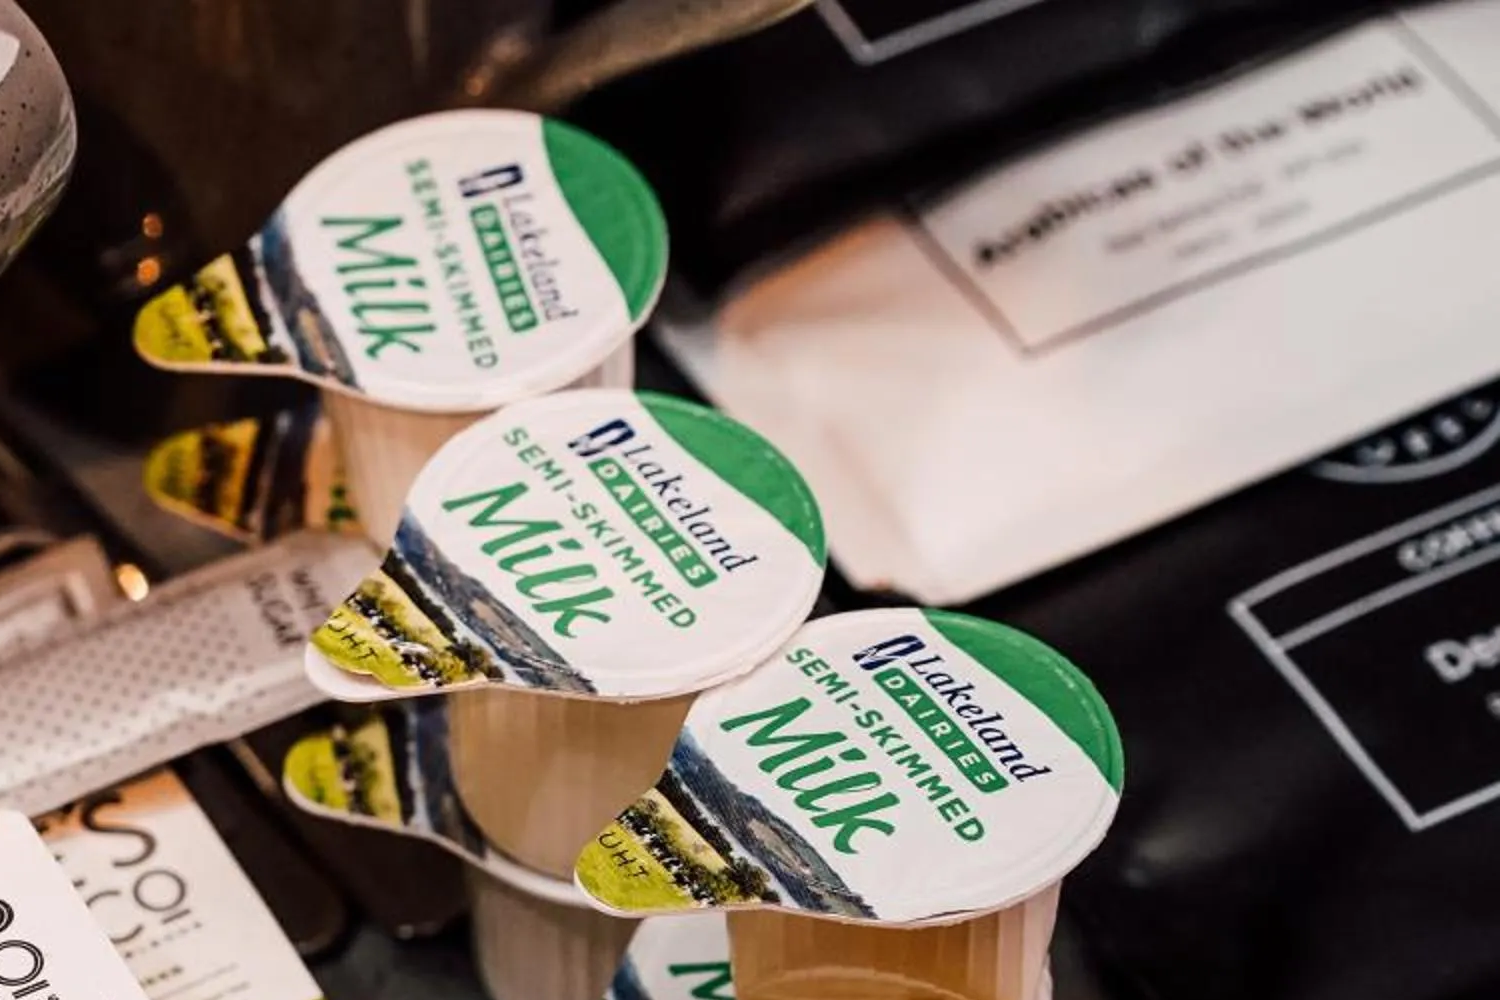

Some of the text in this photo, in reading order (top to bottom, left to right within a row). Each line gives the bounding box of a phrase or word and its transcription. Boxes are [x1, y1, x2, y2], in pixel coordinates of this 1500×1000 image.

[320, 216, 437, 361] Milk
[406, 158, 498, 370] SEMI-SKIMMED
[441, 482, 612, 640] Milk
[502, 427, 698, 630] SEMI-SKIMMED
[598, 460, 704, 580] DAIRIES
[622, 442, 760, 573] Lakeland
[720, 696, 901, 855] Milk
[785, 647, 985, 844] SEMI-SKIMMED
[887, 673, 994, 791] DAIRIES
[909, 654, 1052, 784] Lakeland
[598, 831, 649, 881] UHT
